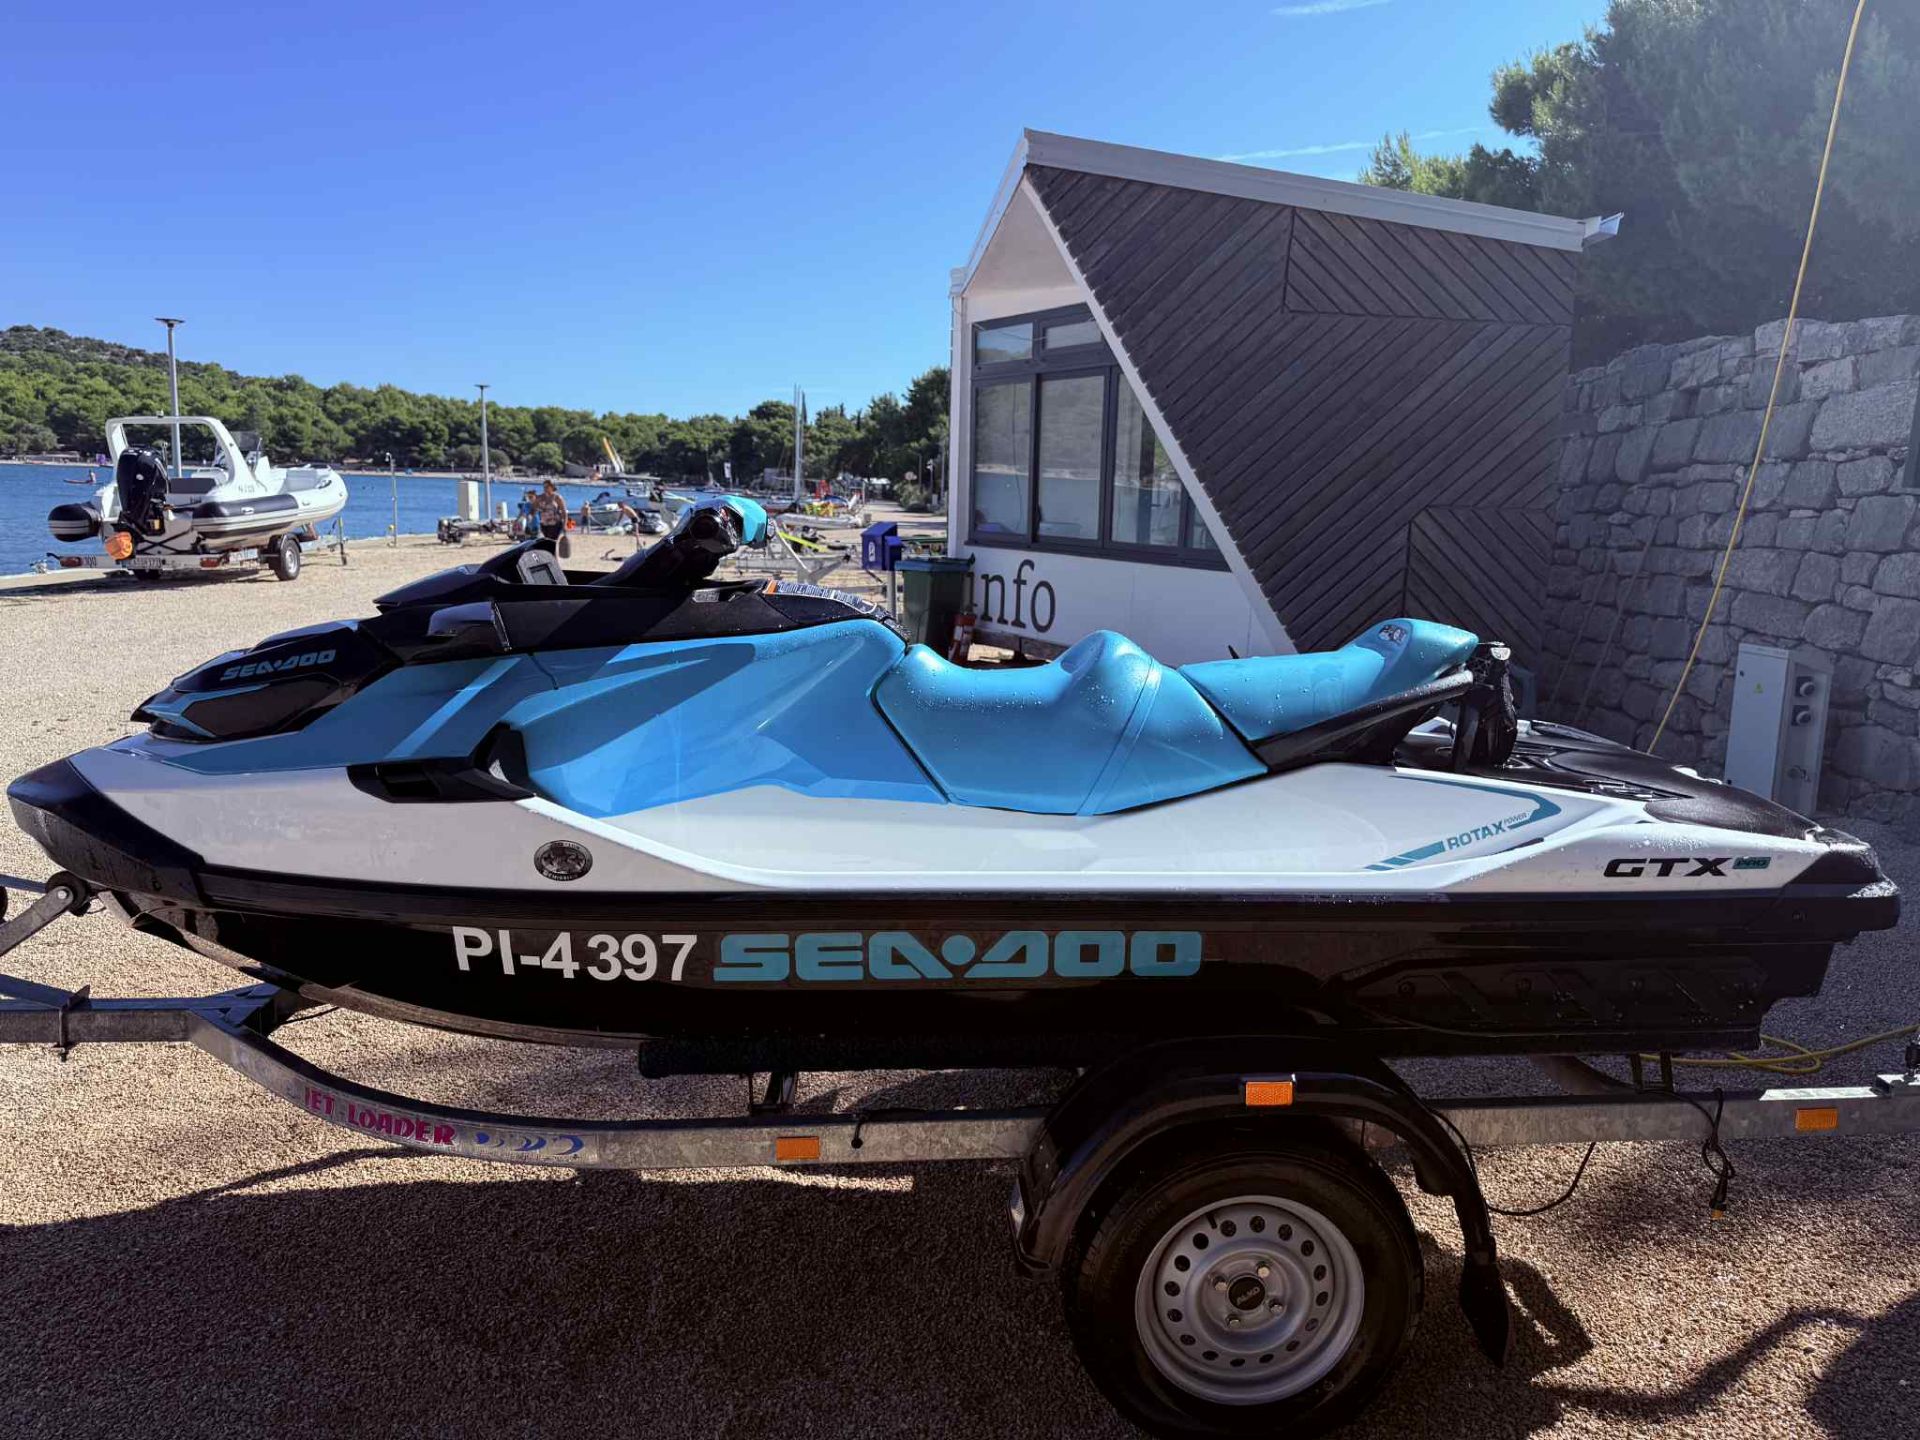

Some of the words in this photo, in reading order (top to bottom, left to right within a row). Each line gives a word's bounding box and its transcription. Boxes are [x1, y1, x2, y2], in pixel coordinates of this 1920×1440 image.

[1446, 820, 1506, 850] ROTAX
[1603, 857, 1733, 877] GTX
[348, 1103, 457, 1147] LOADER
